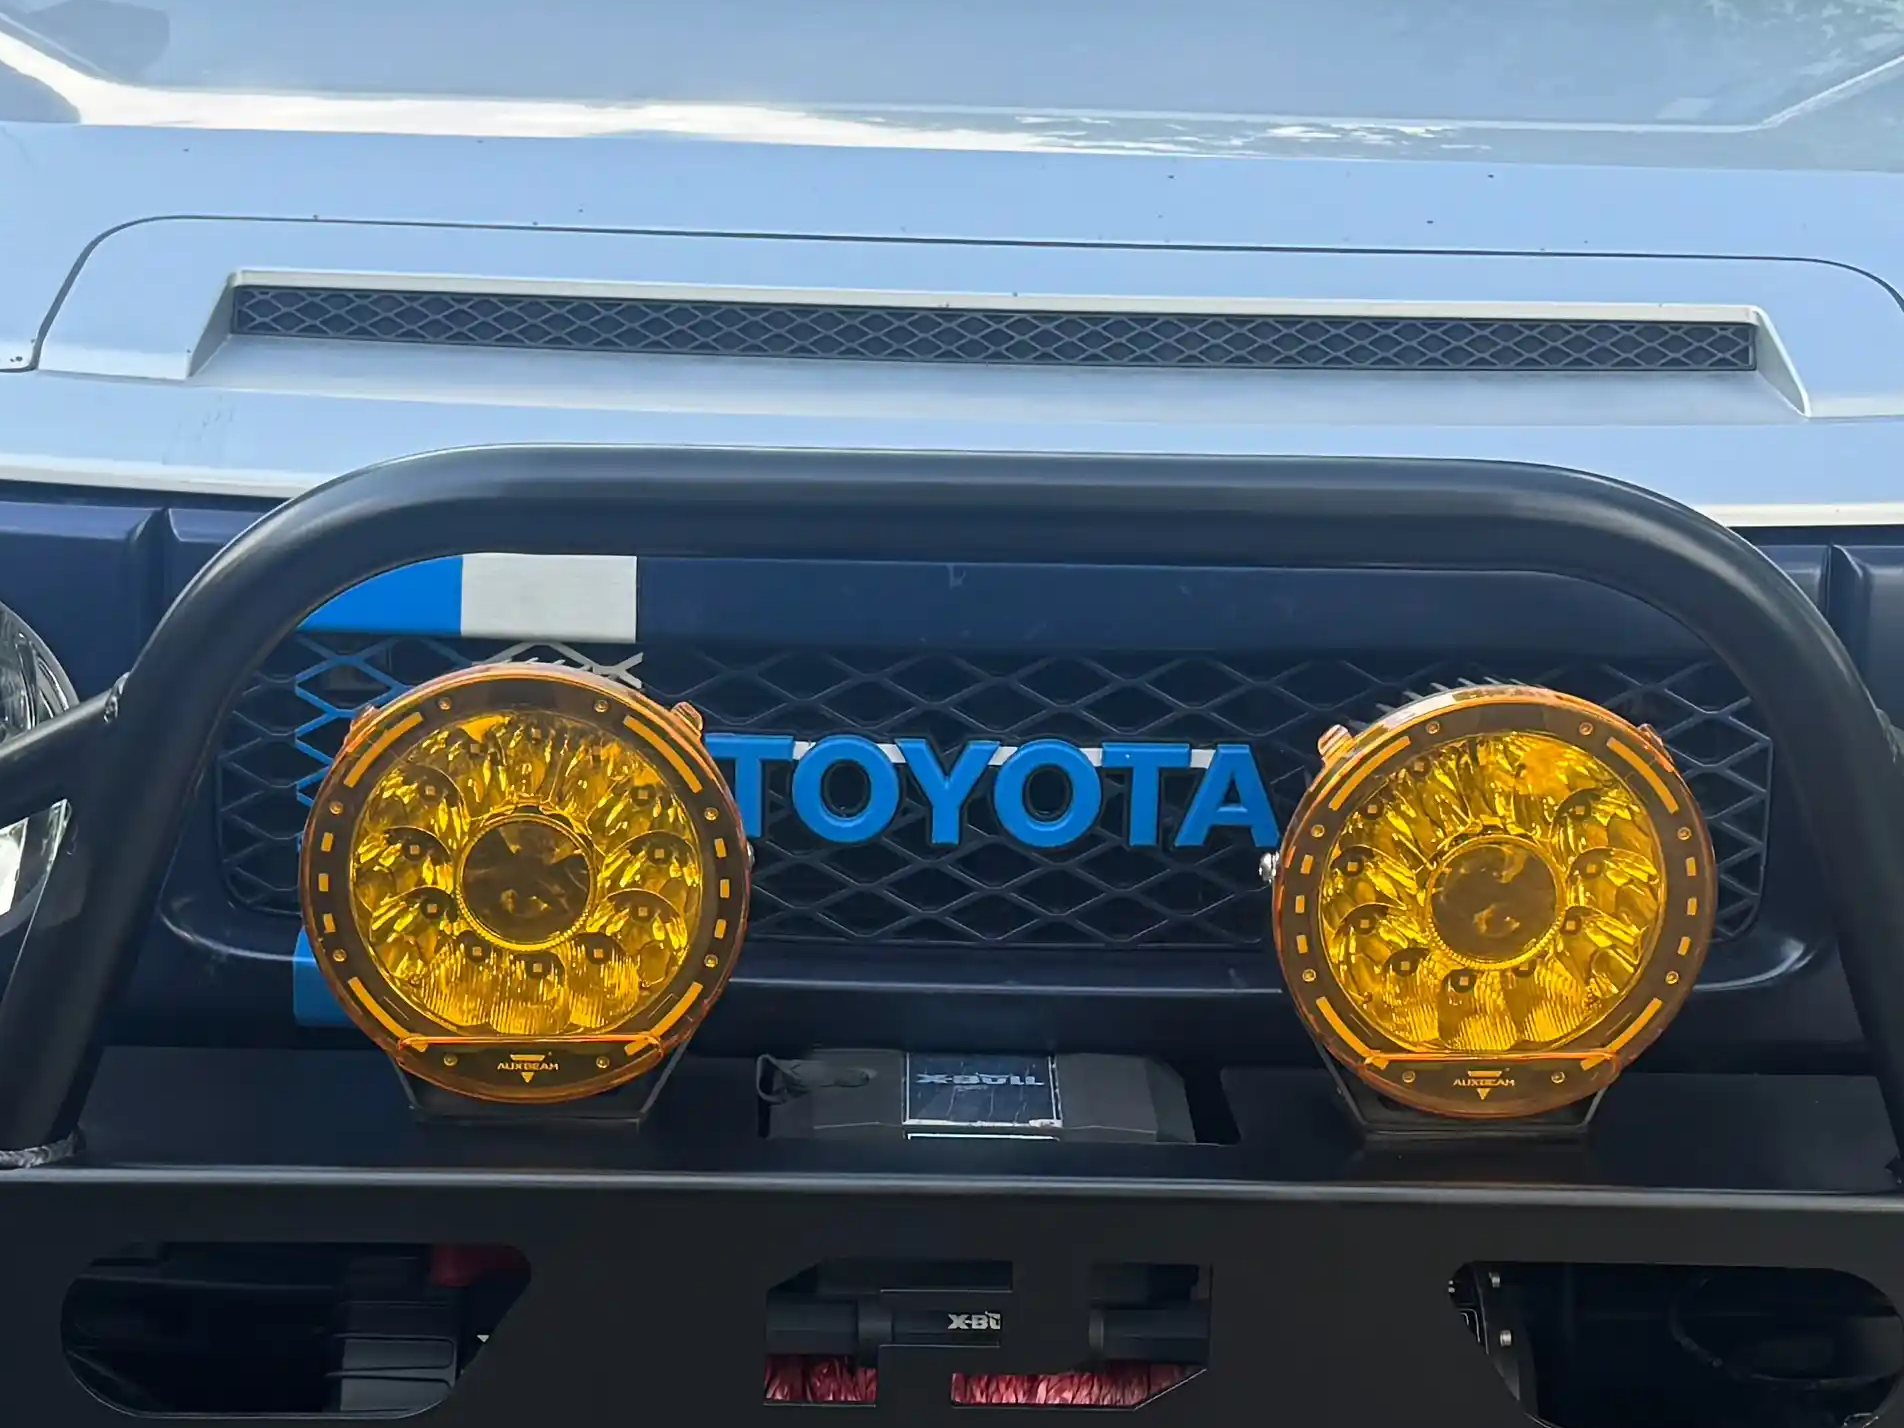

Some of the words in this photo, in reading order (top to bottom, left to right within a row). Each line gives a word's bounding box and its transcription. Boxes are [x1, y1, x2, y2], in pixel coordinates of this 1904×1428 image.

[705, 734, 1282, 849] TOYOTA
[497, 1062, 559, 1071] AUXBEAM
[1453, 1078, 1515, 1087] AUXBEAM
